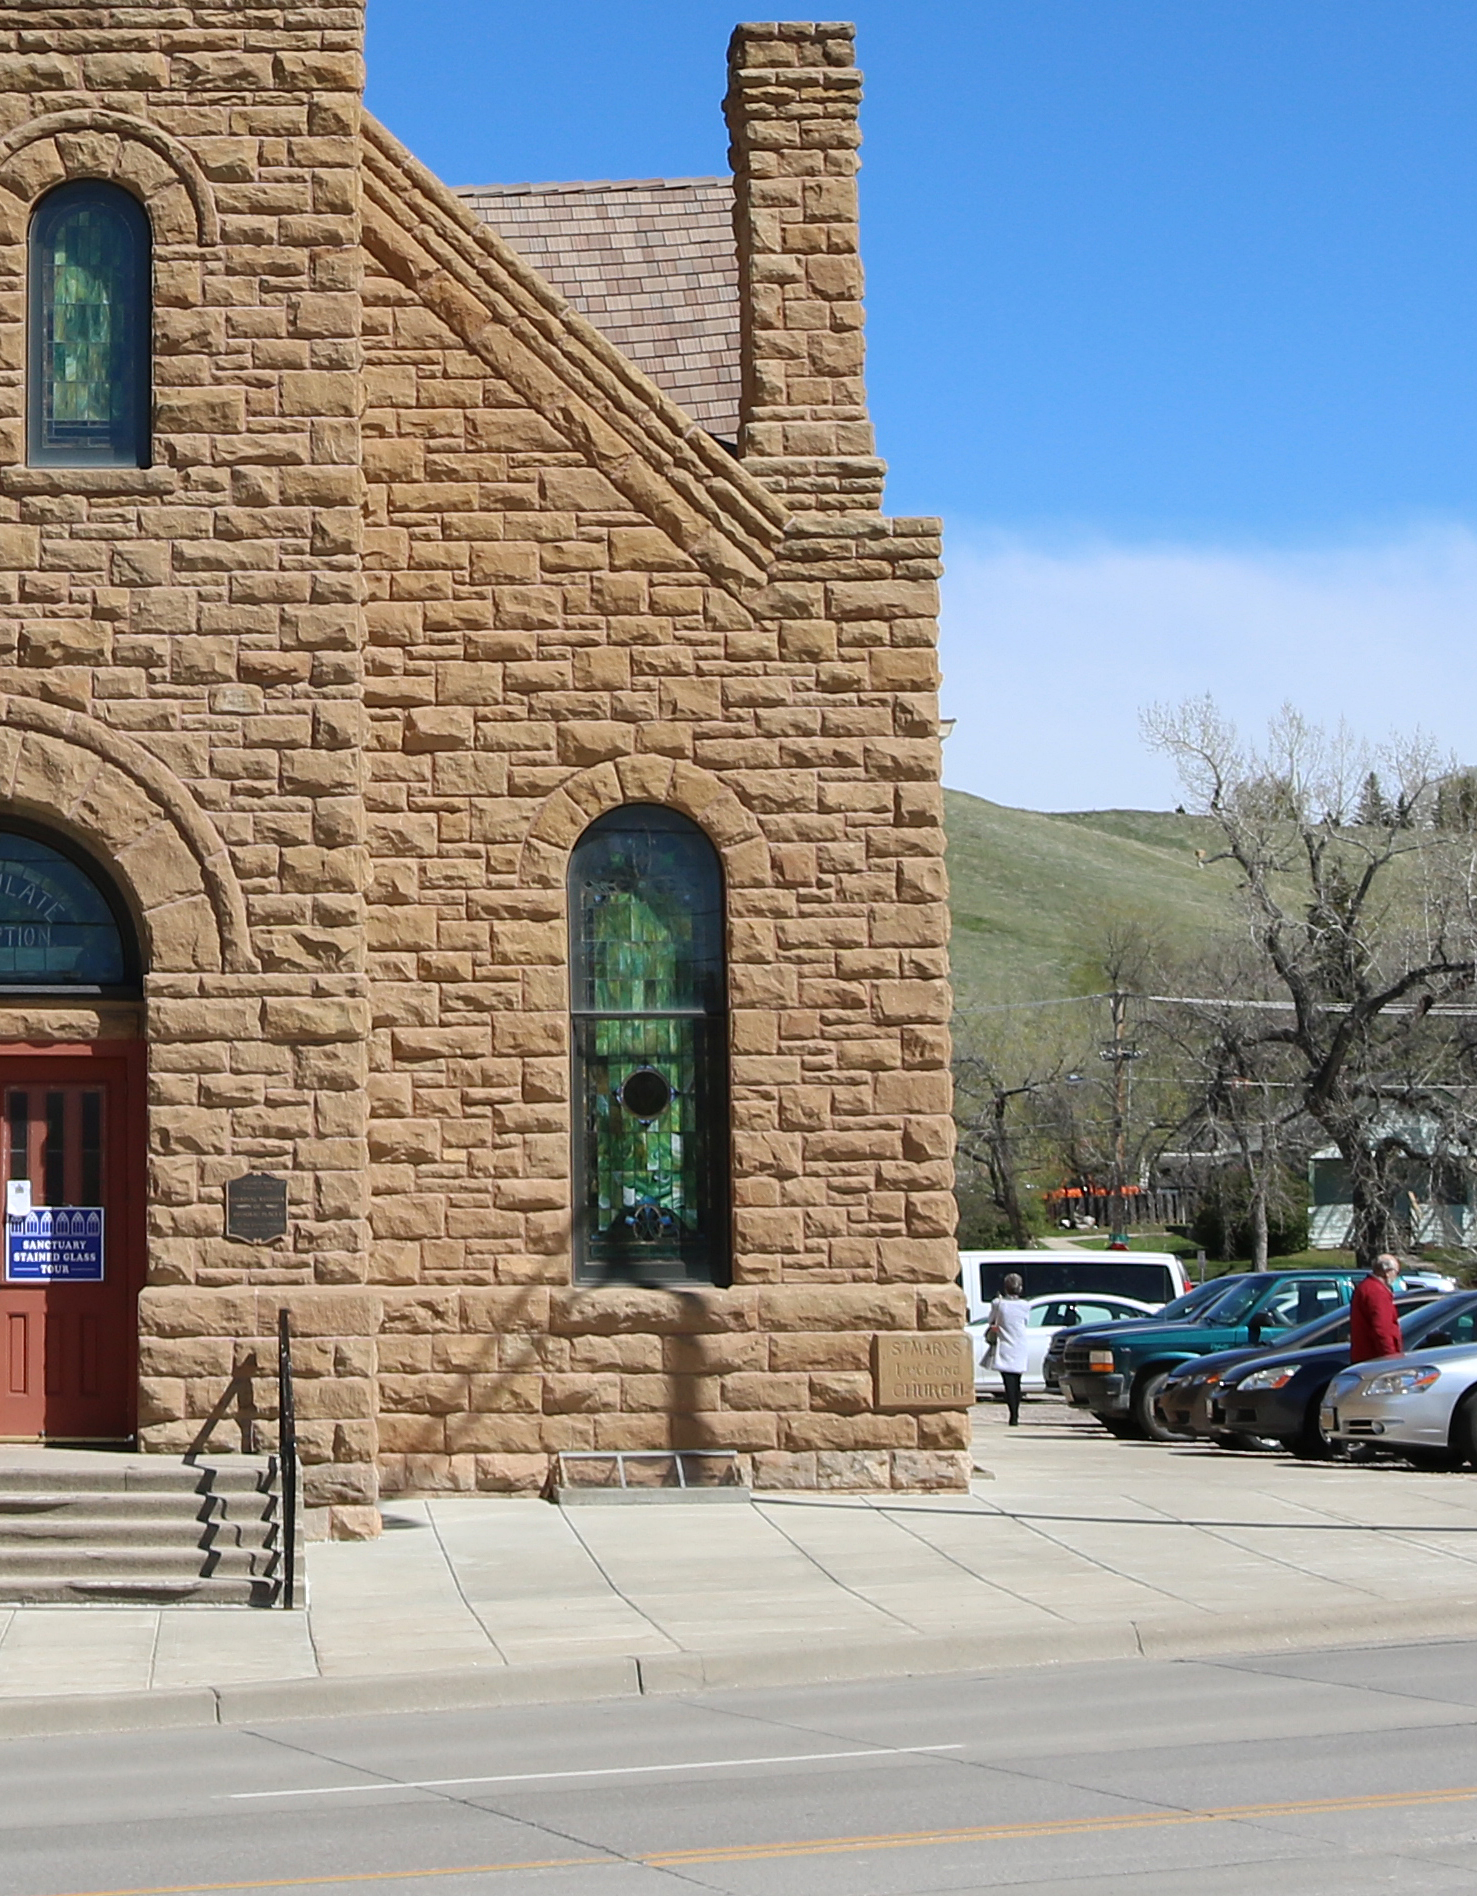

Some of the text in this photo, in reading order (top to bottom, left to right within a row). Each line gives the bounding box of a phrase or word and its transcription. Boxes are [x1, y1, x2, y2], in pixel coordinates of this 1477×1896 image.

[23, 1240, 86, 1250] SANCTUARY
[13, 1252, 96, 1262] STAINED GLASS
[40, 1265, 69, 1274] TOUR
[893, 1383, 964, 1400] CHURCH
